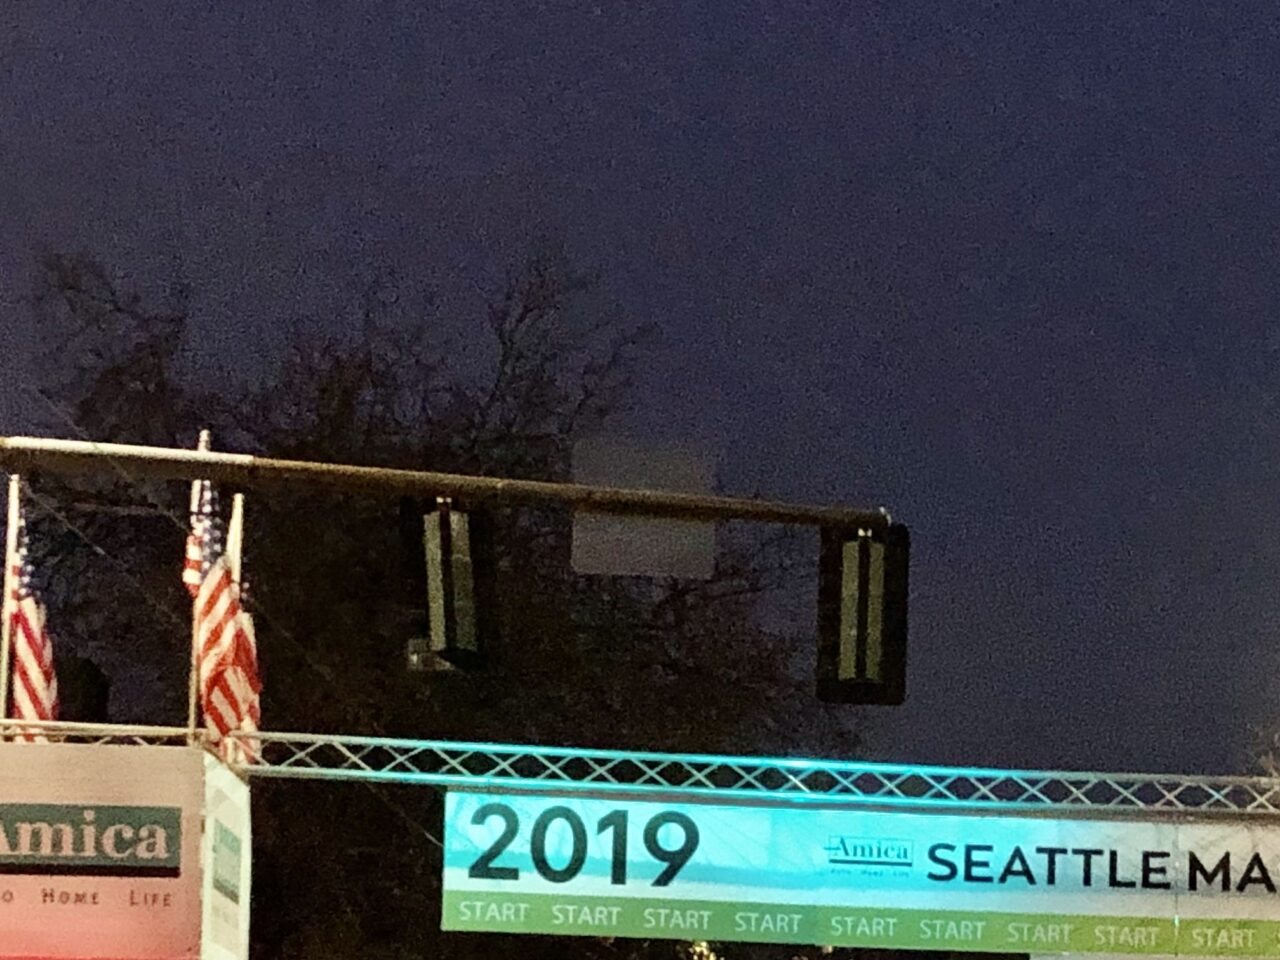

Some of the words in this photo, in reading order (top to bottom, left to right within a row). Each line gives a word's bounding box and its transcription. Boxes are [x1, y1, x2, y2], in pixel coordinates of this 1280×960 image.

[469, 802, 700, 888] 2019
[927, 842, 1171, 889] SEATTLE
[458, 901, 530, 923] START
[552, 904, 622, 926] START
[643, 908, 713, 931] START
[735, 912, 803, 935] START
[830, 916, 897, 938] START
[919, 920, 987, 940] START
[1007, 922, 1074, 944] START
[1094, 925, 1160, 947] START
[1191, 926, 1255, 948] START
